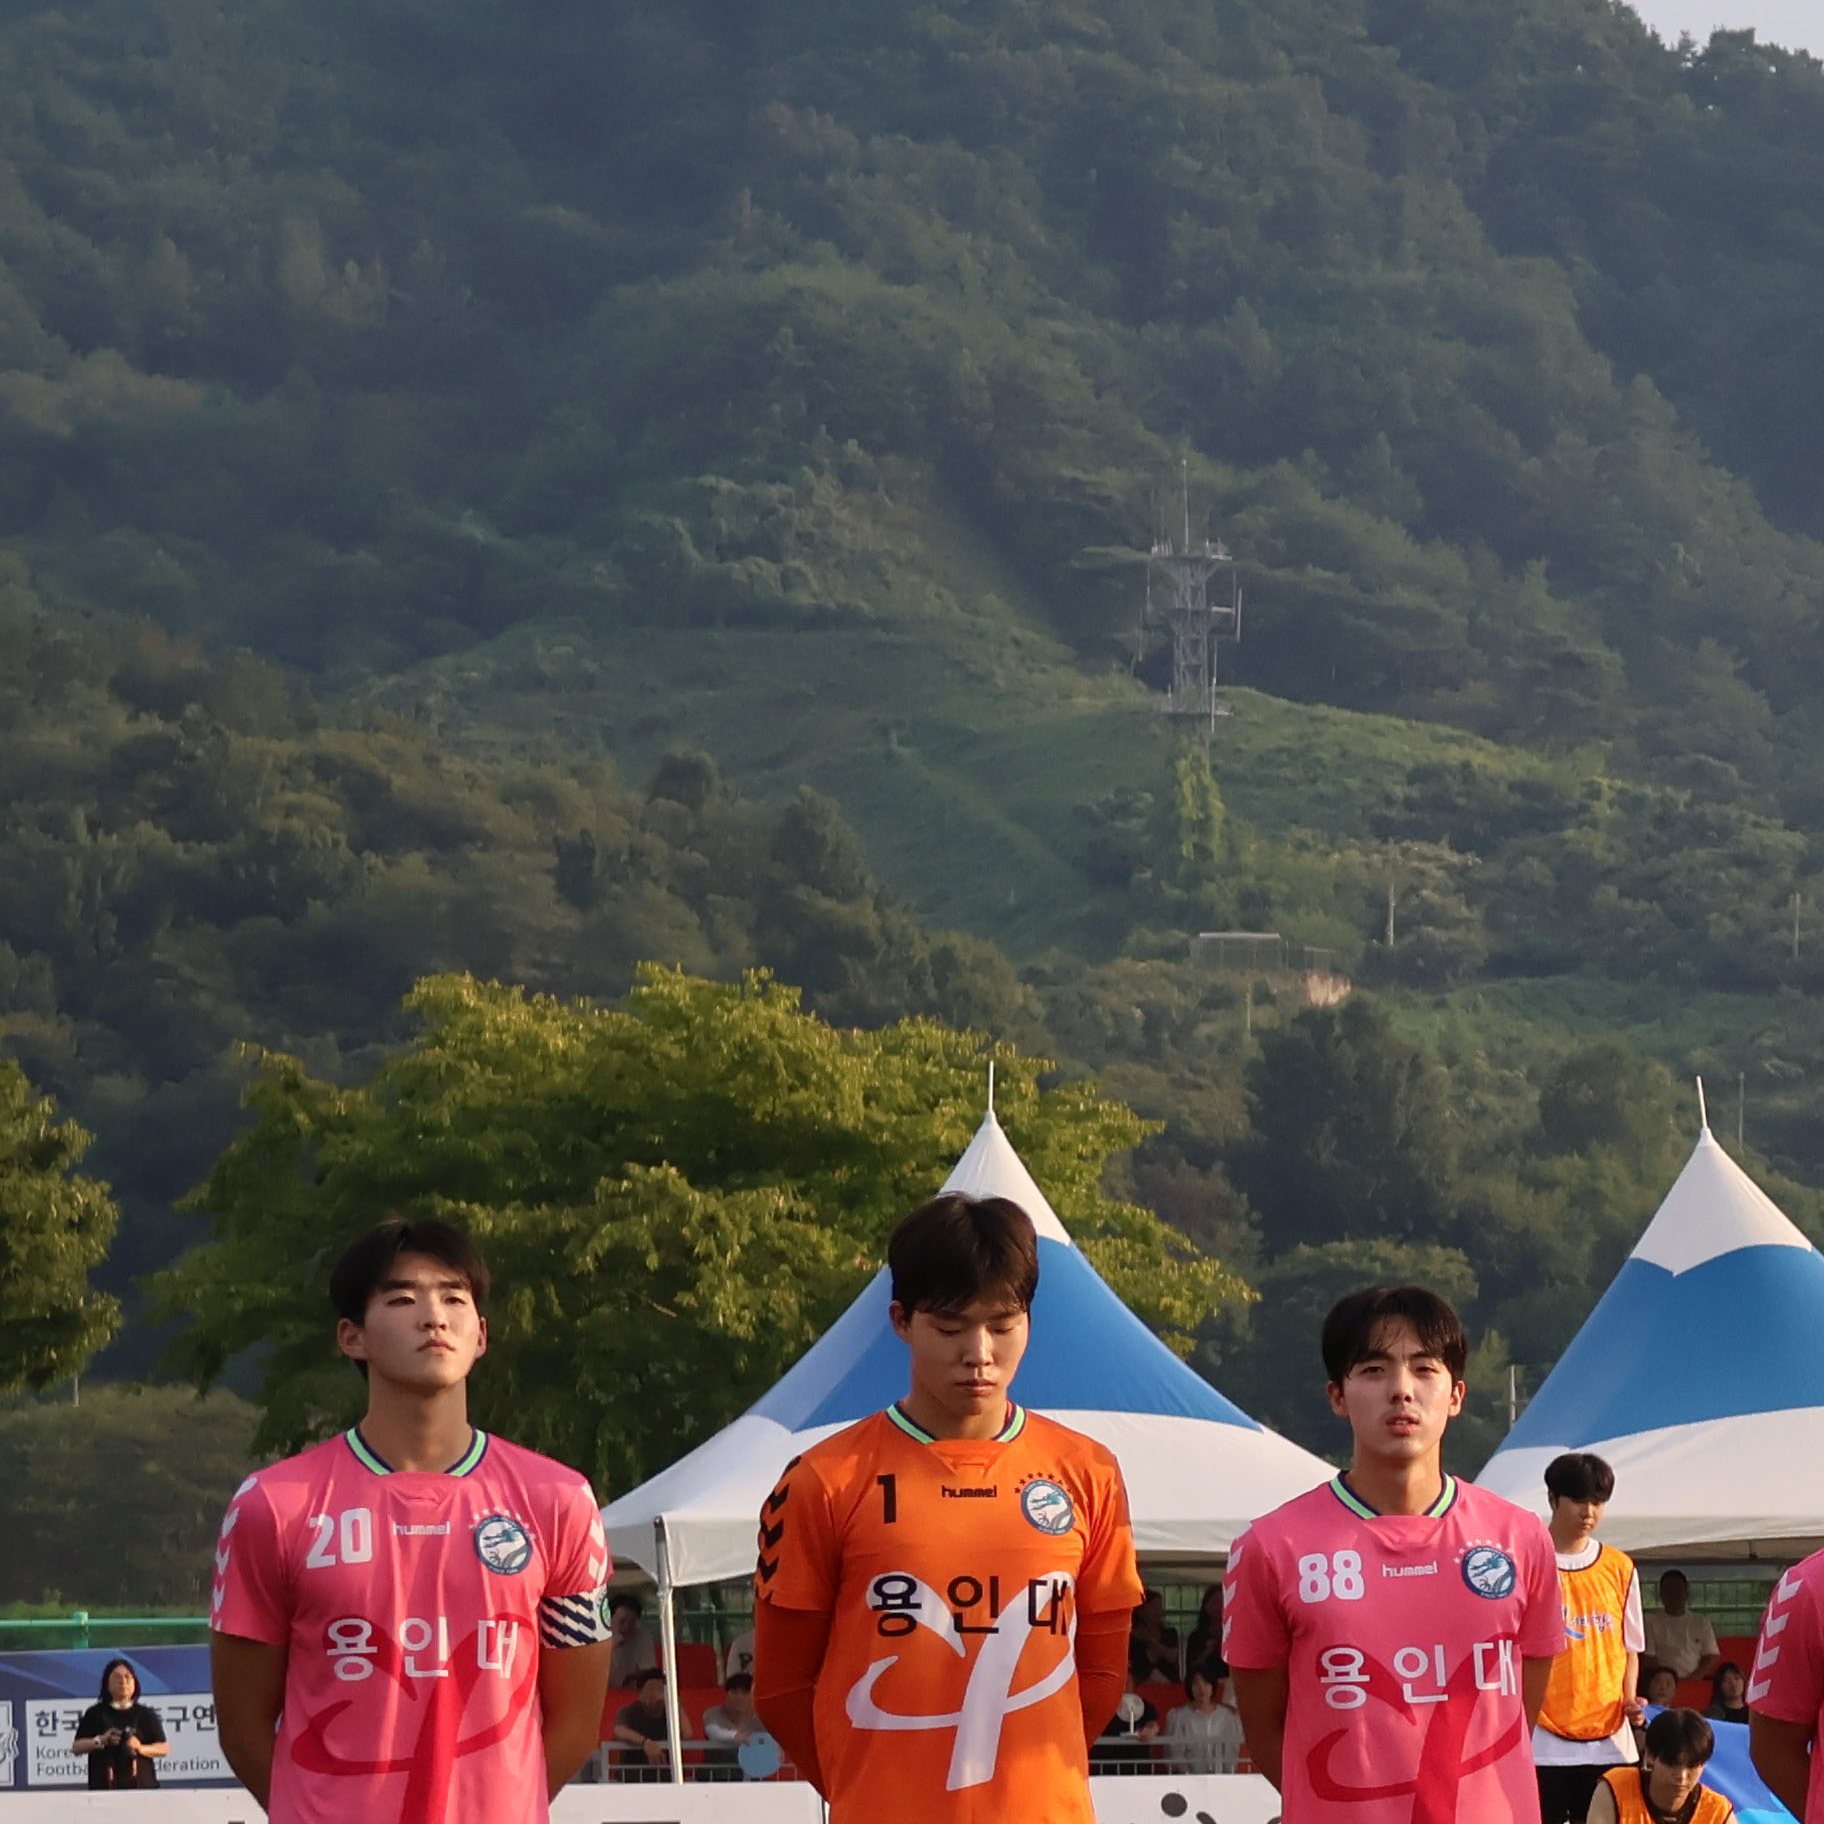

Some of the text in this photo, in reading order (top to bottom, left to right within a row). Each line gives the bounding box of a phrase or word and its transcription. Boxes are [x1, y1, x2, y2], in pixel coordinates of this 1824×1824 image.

[876, 1473, 897, 1524] 1
[941, 1485, 997, 1498] hummel
[306, 1507, 373, 1569] 20
[393, 1521, 451, 1536] hummel
[1298, 1550, 1366, 1603] 88
[1382, 1561, 1438, 1578] hummel
[872, 1574, 1068, 1638] 용인대
[327, 1616, 519, 1681] 용인대
[1320, 1639, 1516, 1709] 용인대
